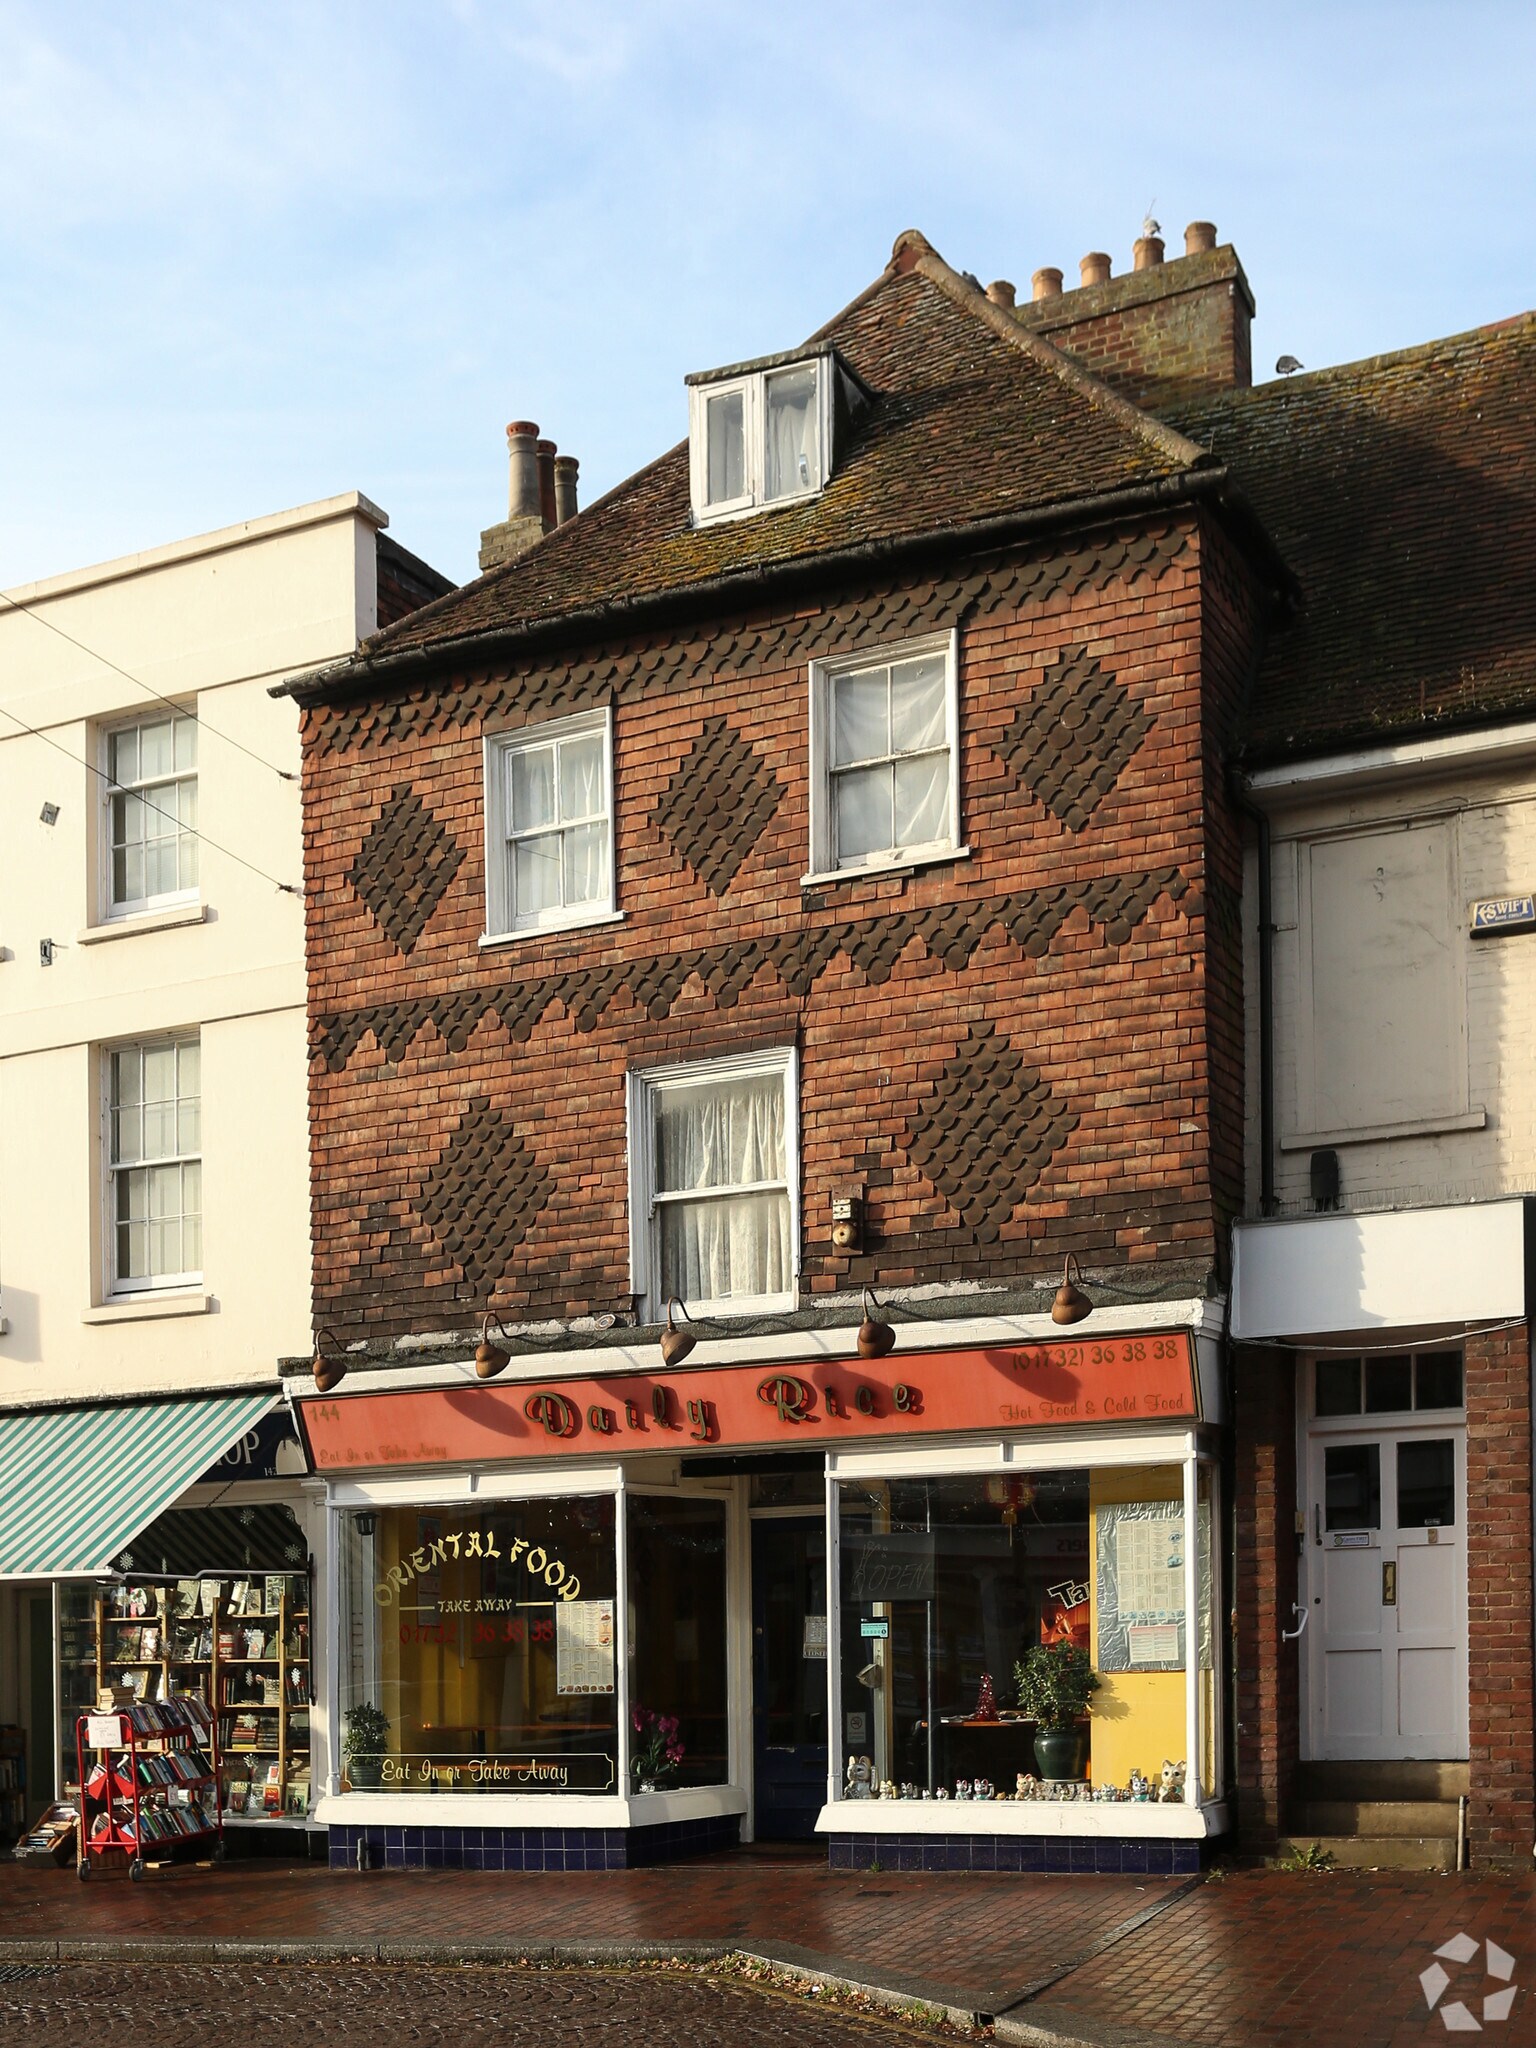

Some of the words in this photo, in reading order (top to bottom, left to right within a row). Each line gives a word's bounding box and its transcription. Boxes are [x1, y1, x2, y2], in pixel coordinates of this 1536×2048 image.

[1486, 898, 1530, 920] SWIFT
[1091, 1345, 1115, 1365] 36
[1122, 1342, 1147, 1363] 38
[1152, 1339, 1178, 1360] 38
[310, 1404, 340, 1422] 144
[522, 1384, 709, 1440] Daily
[756, 1373, 911, 1422] Rice
[1000, 1403, 1033, 1422] Hot
[1039, 1401, 1078, 1419] Food
[1103, 1397, 1137, 1414] Cold
[1144, 1393, 1184, 1412] Food
[216, 1430, 260, 1467] OP
[320, 1449, 339, 1464] Eat
[414, 1443, 447, 1460] Away
[373, 1530, 502, 1607] ORIENTAL
[510, 1536, 581, 1602] FOOD
[868, 1563, 931, 1592] OPEN
[437, 1600, 471, 1613] TAKE
[474, 1598, 513, 1612] AWAY
[473, 1622, 496, 1643] 36
[501, 1619, 525, 1643] 38
[531, 1618, 555, 1642] 38
[381, 1759, 411, 1782] Eat
[418, 1759, 439, 1782] In
[447, 1768, 461, 1781] or
[467, 1760, 511, 1783] Take
[518, 1758, 569, 1787] Away
